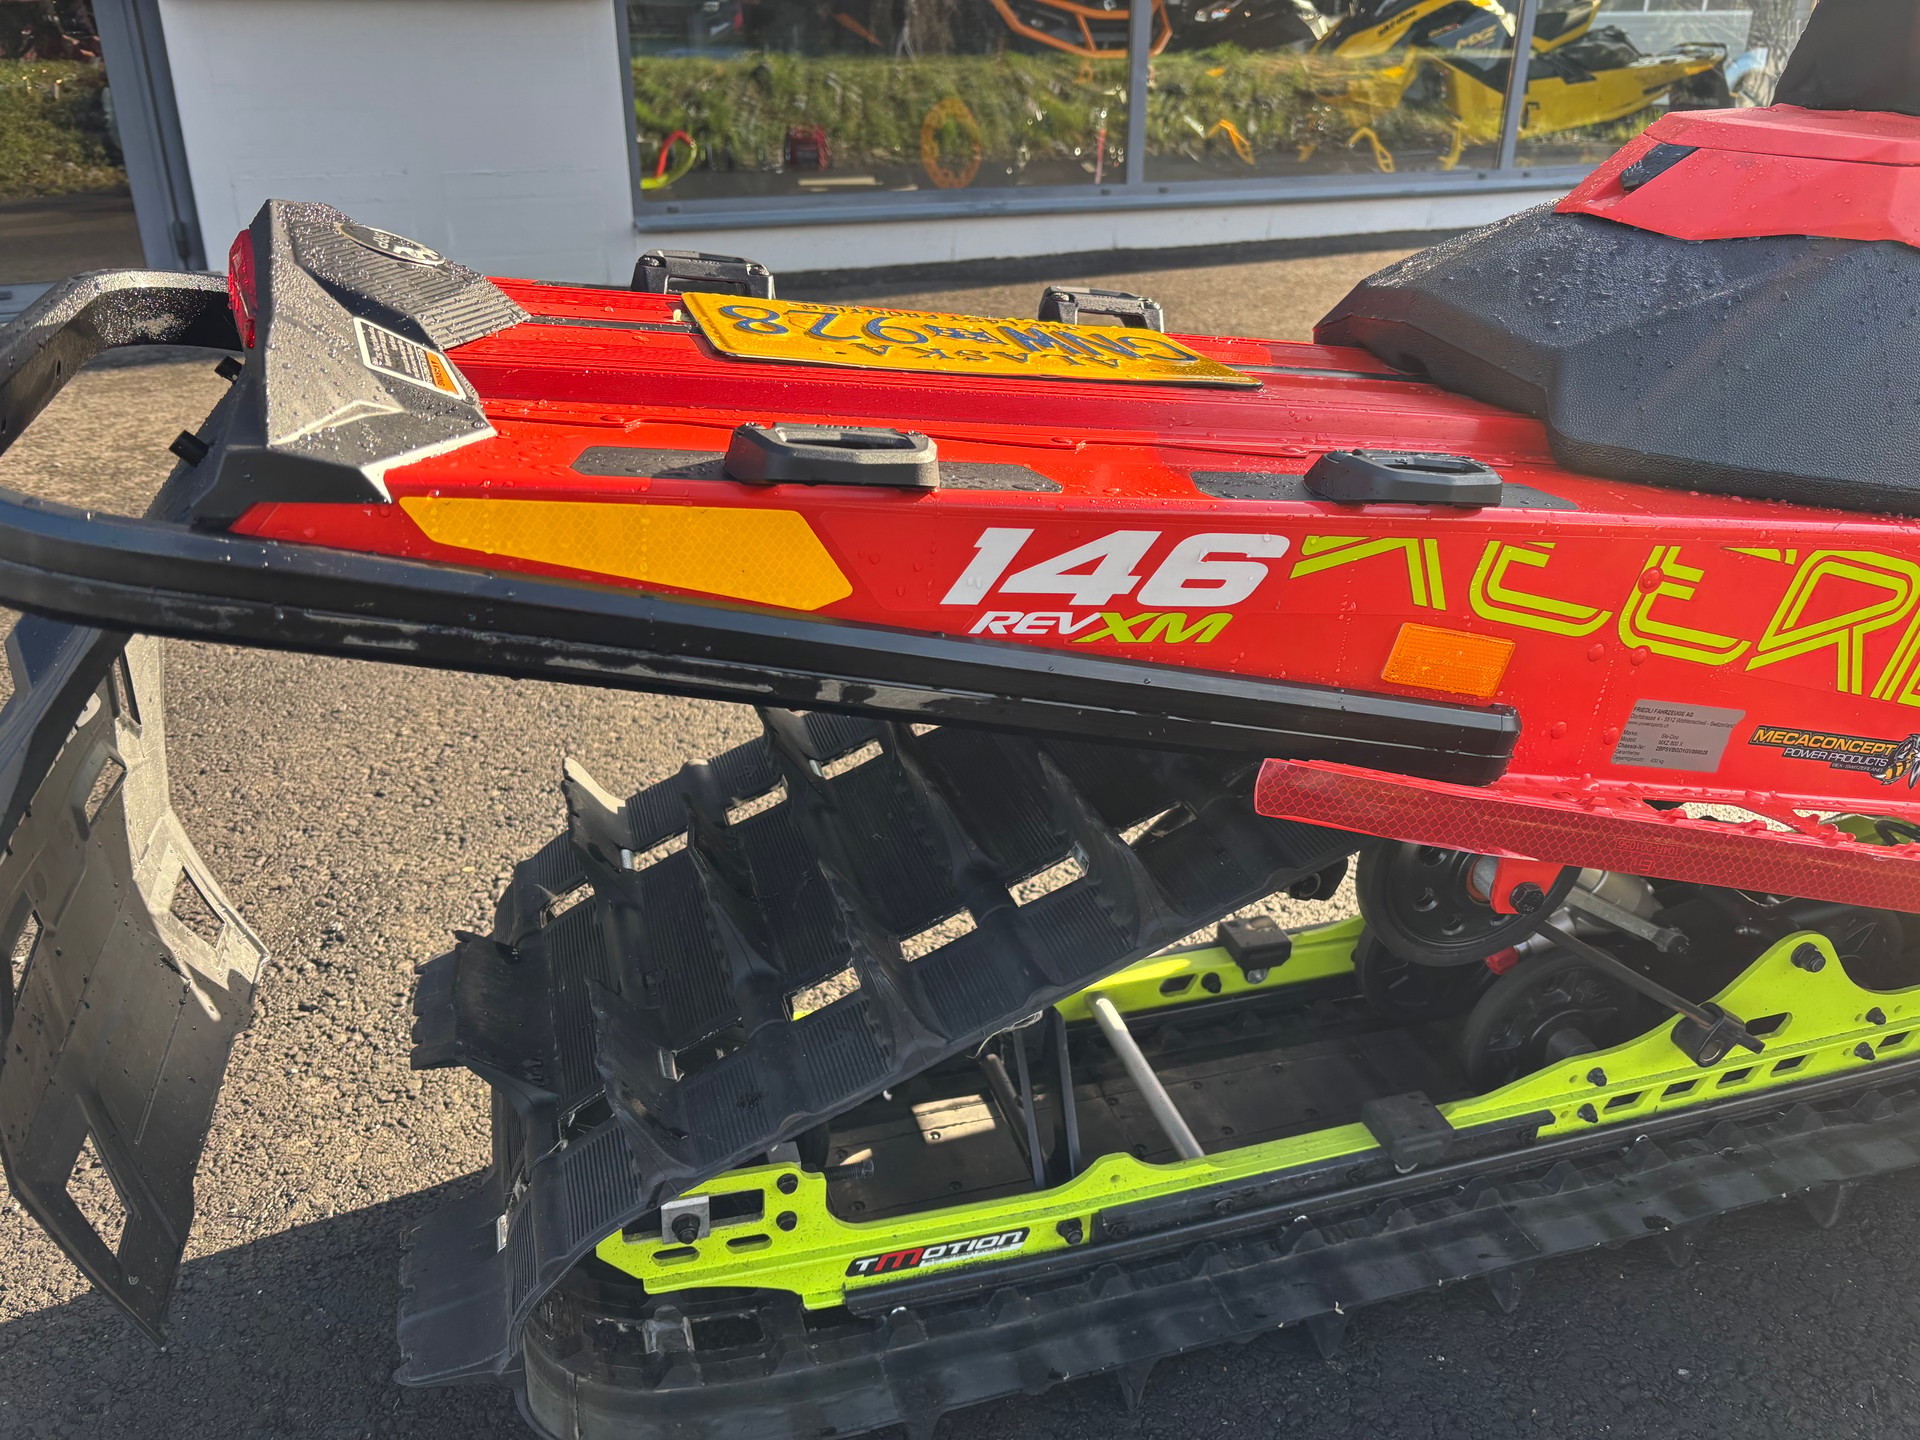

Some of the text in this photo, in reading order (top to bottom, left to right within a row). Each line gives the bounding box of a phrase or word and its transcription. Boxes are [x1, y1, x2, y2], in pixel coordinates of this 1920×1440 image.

[719, 304, 1200, 363] GNW 928
[848, 342, 1121, 369] ALASKA
[939, 526, 1291, 608] 146
[1753, 728, 1898, 757] MECACONCEPT
[1783, 747, 1889, 768] POWER PRODUCTS
